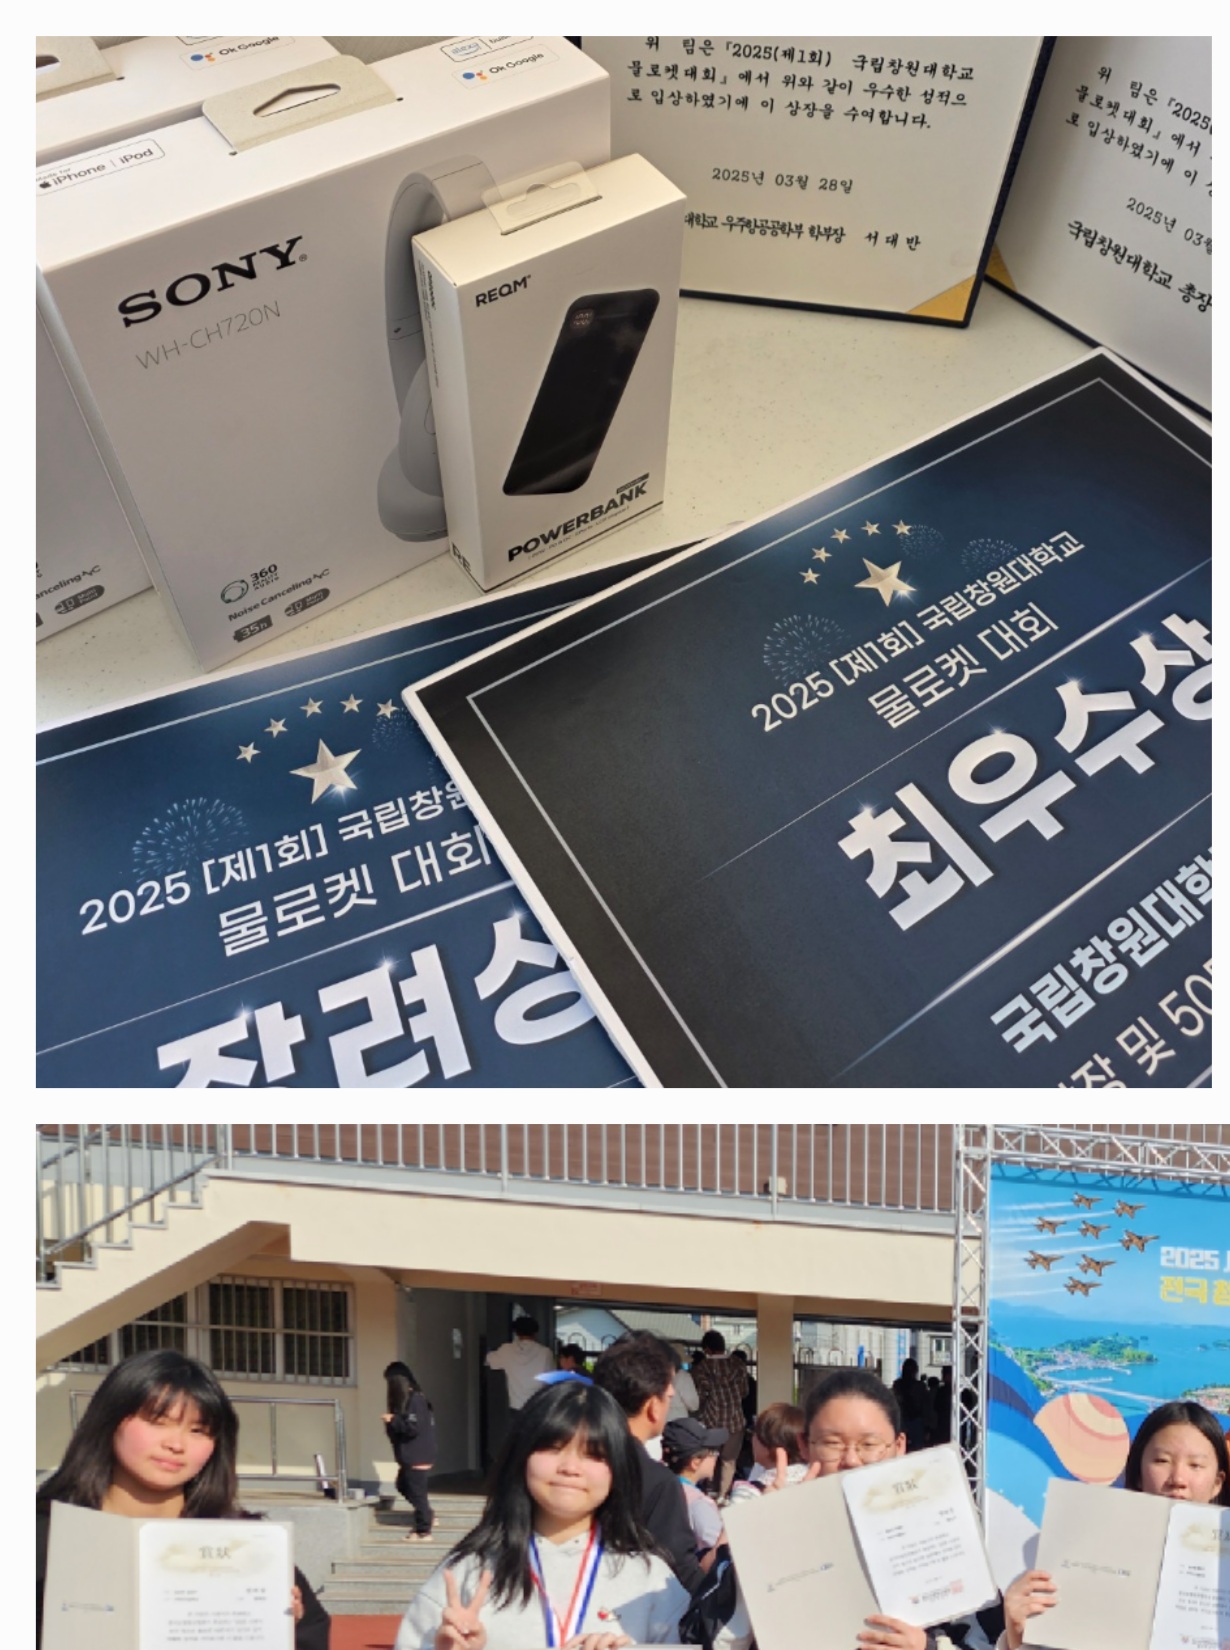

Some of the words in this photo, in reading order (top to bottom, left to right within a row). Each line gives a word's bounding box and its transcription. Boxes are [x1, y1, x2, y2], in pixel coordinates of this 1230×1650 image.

[489, 65, 506, 75] Ok
[505, 53, 545, 69] Google
[645, 36, 660, 51] 위
[852, 54, 975, 82] 국립창원대학교
[1097, 66, 1113, 84] 위
[626, 88, 643, 102] 로
[650, 90, 749, 111] 입상하였기에
[760, 98, 775, 114] 이
[784, 101, 834, 120] 상장을
[843, 105, 932, 130] 수여합니다.
[781, 73, 814, 91] 위와
[821, 77, 853, 96] 같이
[862, 82, 912, 104] 우수한
[918, 88, 968, 107] 성적으
[53, 163, 106, 187] iPhone
[119, 148, 154, 167] iPod
[1066, 111, 1080, 127] 로
[1087, 120, 1175, 174] 입상하였기에
[1183, 169, 1199, 187] 이
[711, 167, 765, 186] 2025년
[774, 173, 809, 190] 03월
[818, 178, 854, 195] 28일
[721, 215, 804, 239] 우주항공공학부
[808, 223, 846, 244] 학부장
[1126, 197, 1177, 233] 2025년
[117, 234, 304, 329] SONY
[1067, 220, 1173, 290] 국립창원대학교
[1178, 282, 1212, 314] 총장
[475, 275, 529, 309] REQM
[135, 300, 282, 371] WH-CH720N
[508, 481, 648, 562] POWERBANK
[36, 576, 82, 600] anceling
[250, 564, 278, 582] 360
[228, 602, 260, 622] Noise
[261, 577, 312, 606] Canceling
[751, 671, 835, 733] 2025
[835, 623, 925, 684] [제1회]
[915, 528, 1085, 630] 국립창원대학교
[868, 645, 987, 730] 물로켓
[978, 602, 1060, 659] 대회
[78, 871, 191, 936] 2025
[202, 823, 329, 895] [제1회]
[217, 862, 378, 957] 물로켓
[391, 824, 493, 893] 대회
[1056, 1054, 1128, 1088] 장
[1115, 1015, 1177, 1078] 및
[1160, 1246, 1220, 1272] 2025
[1159, 1276, 1208, 1304] 전국
